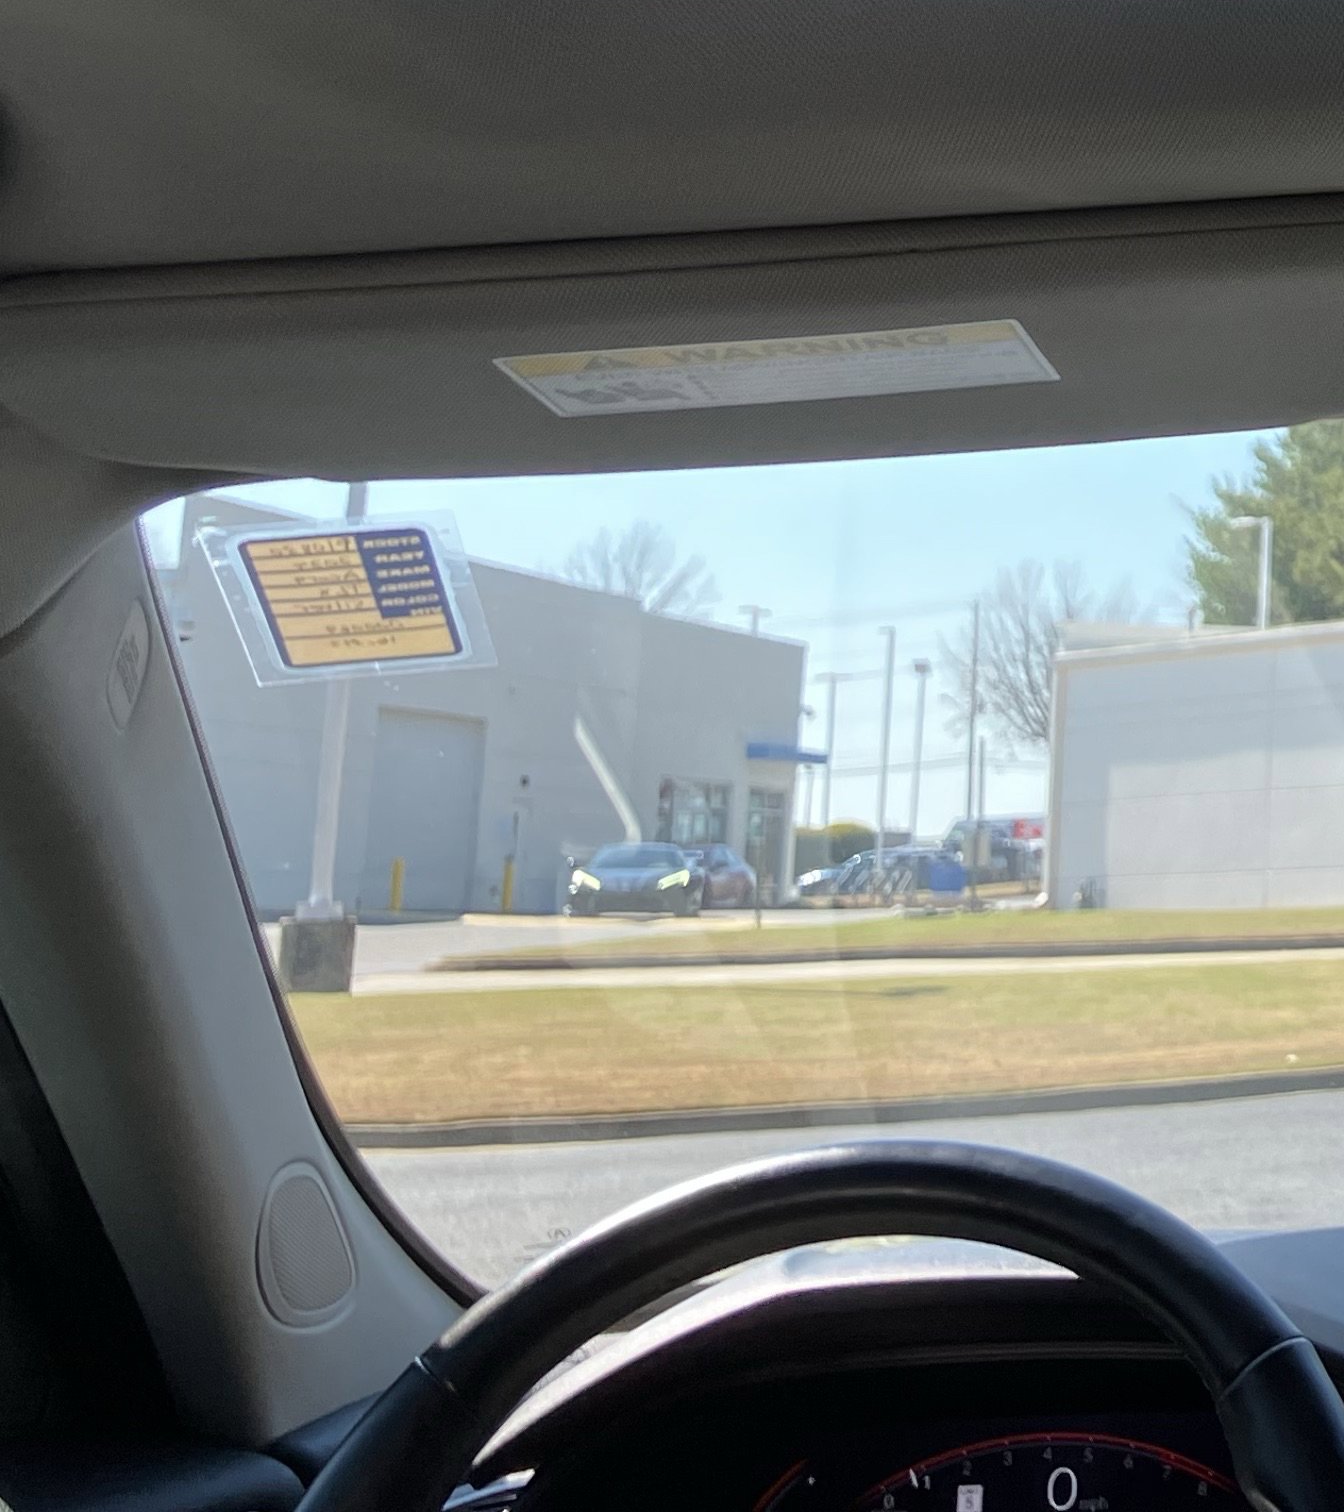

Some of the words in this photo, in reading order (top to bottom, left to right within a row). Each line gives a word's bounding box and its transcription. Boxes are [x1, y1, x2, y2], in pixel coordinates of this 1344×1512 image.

[668, 332, 949, 365] WARNING
[1003, 1451, 1013, 1466] 3
[1042, 1447, 1053, 1460] 4
[1083, 1447, 1094, 1463] 5
[1123, 1454, 1134, 1469] 6
[963, 1460, 972, 1476] 2
[921, 1475, 931, 1491] 1
[1047, 1466, 1078, 1512] 0
[883, 1493, 895, 1510] 0
